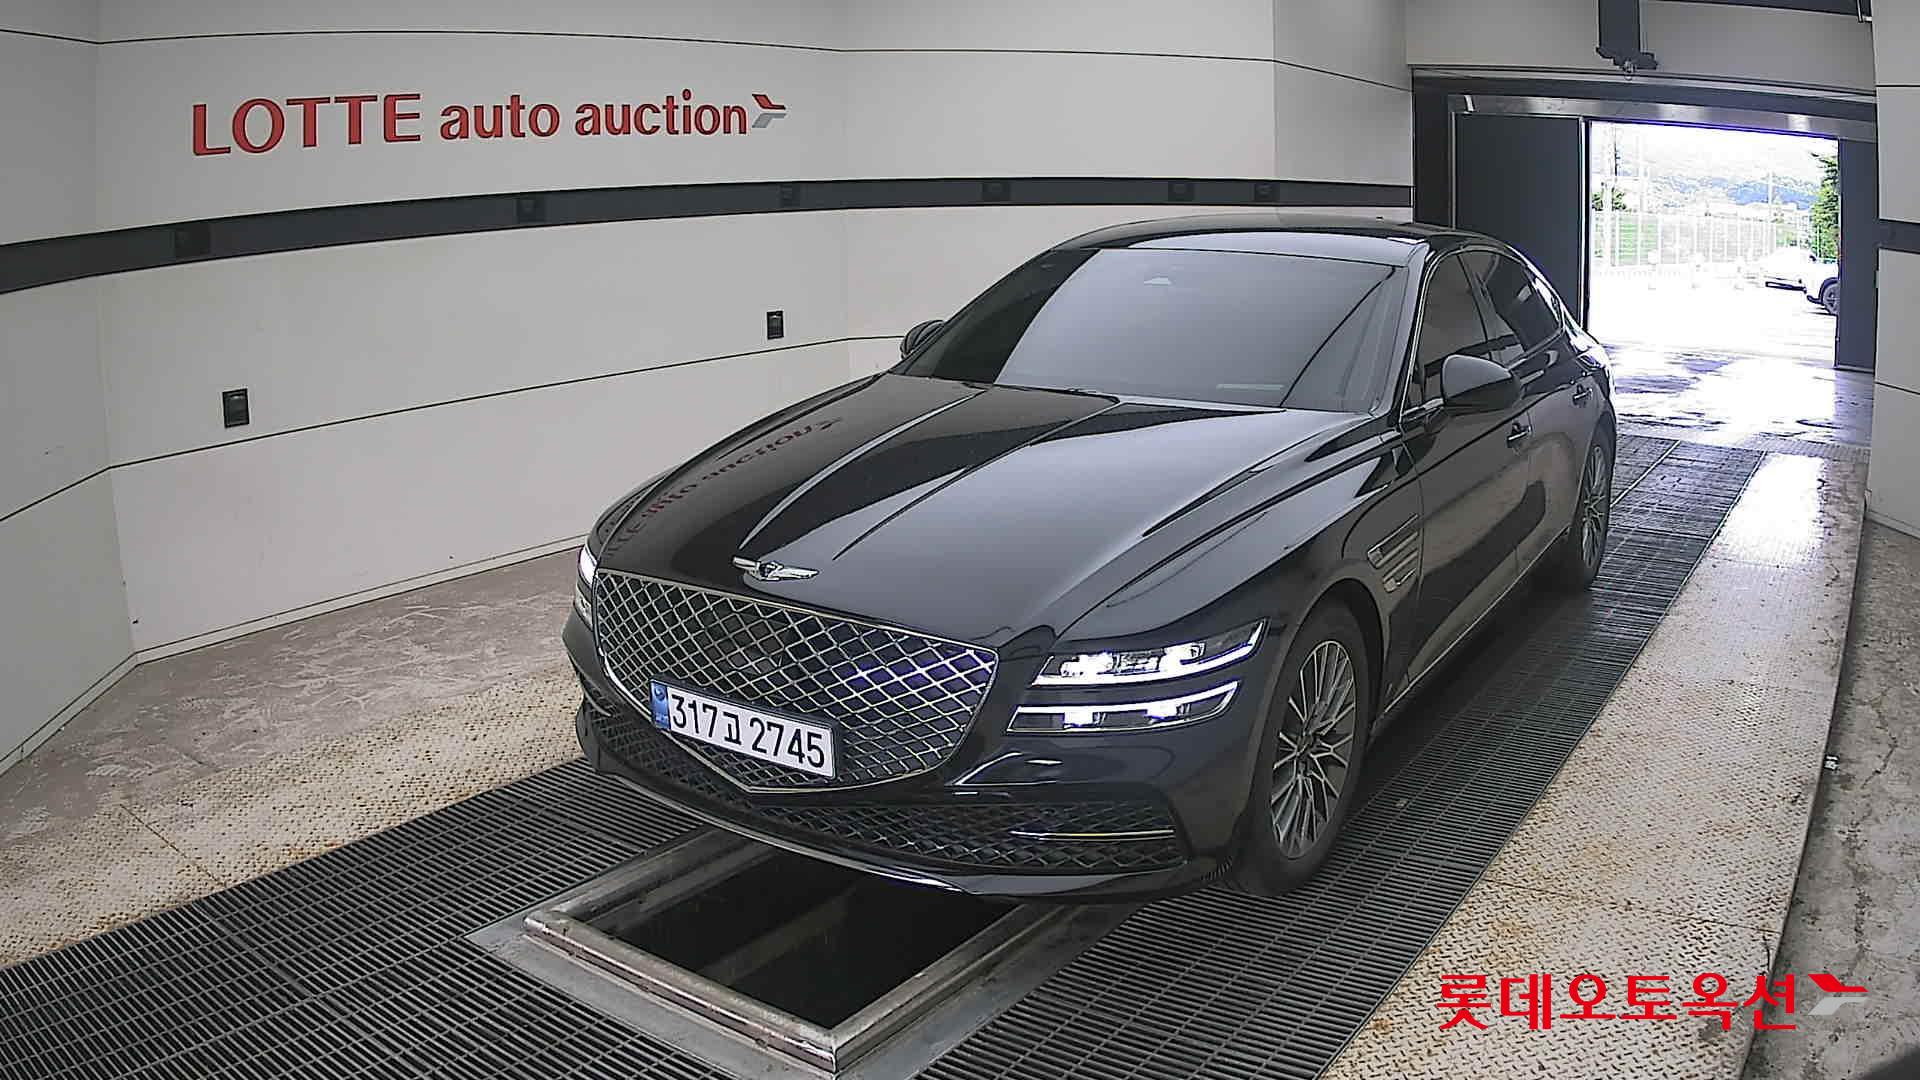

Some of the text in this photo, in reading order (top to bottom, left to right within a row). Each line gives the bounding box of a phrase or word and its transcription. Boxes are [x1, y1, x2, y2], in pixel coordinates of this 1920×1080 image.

[192, 88, 749, 157] LOTTE auto auction
[749, 717, 826, 769] 2745
